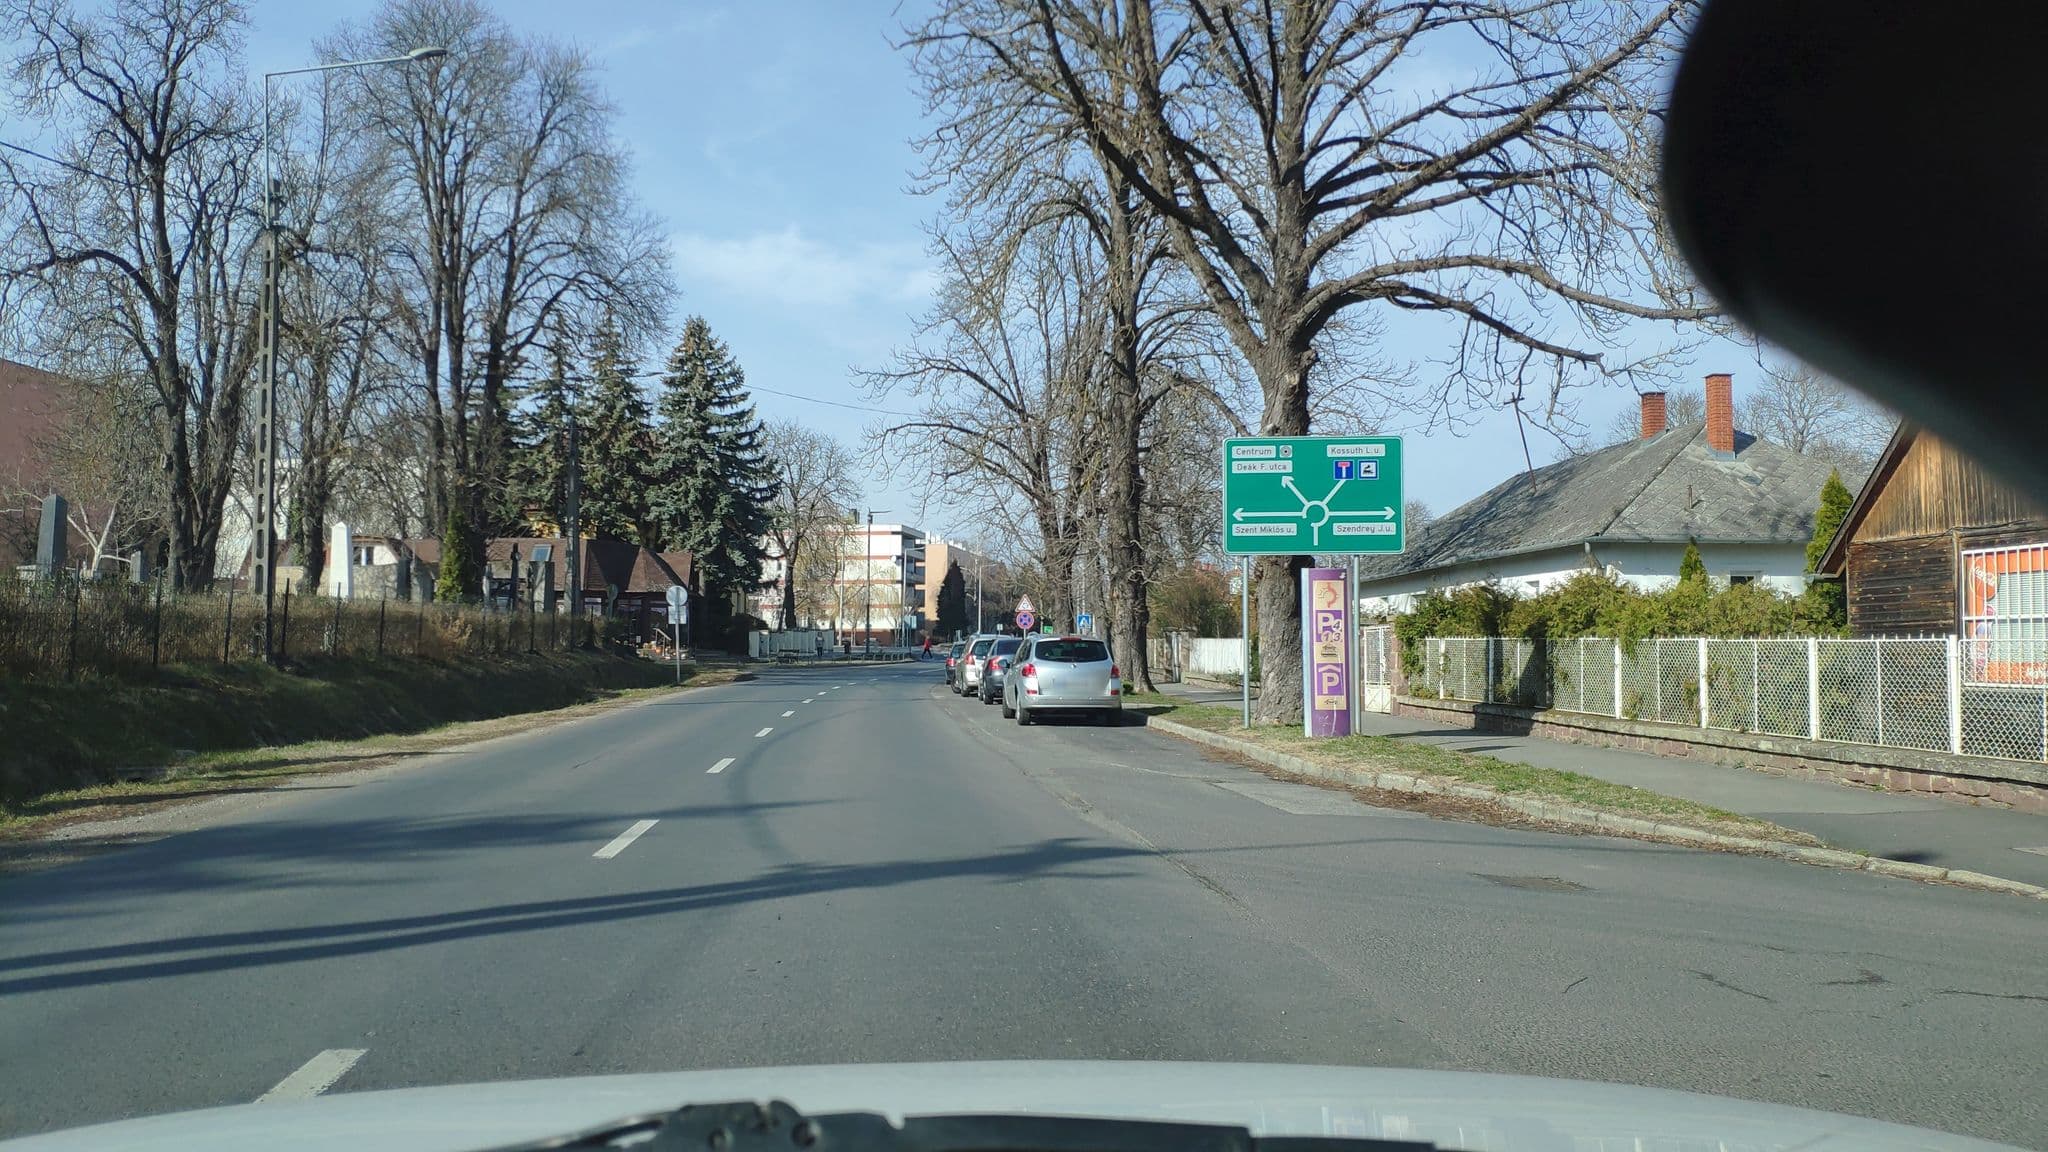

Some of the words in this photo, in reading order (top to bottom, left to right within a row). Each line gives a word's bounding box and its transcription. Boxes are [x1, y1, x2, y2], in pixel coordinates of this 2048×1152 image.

[1331, 447, 1363, 455] Kossuth
[1237, 463, 1257, 471] Deák
[1235, 525, 1257, 534] Szent
[1336, 525, 1375, 534] Szendrey
[1322, 672, 1340, 694] P
